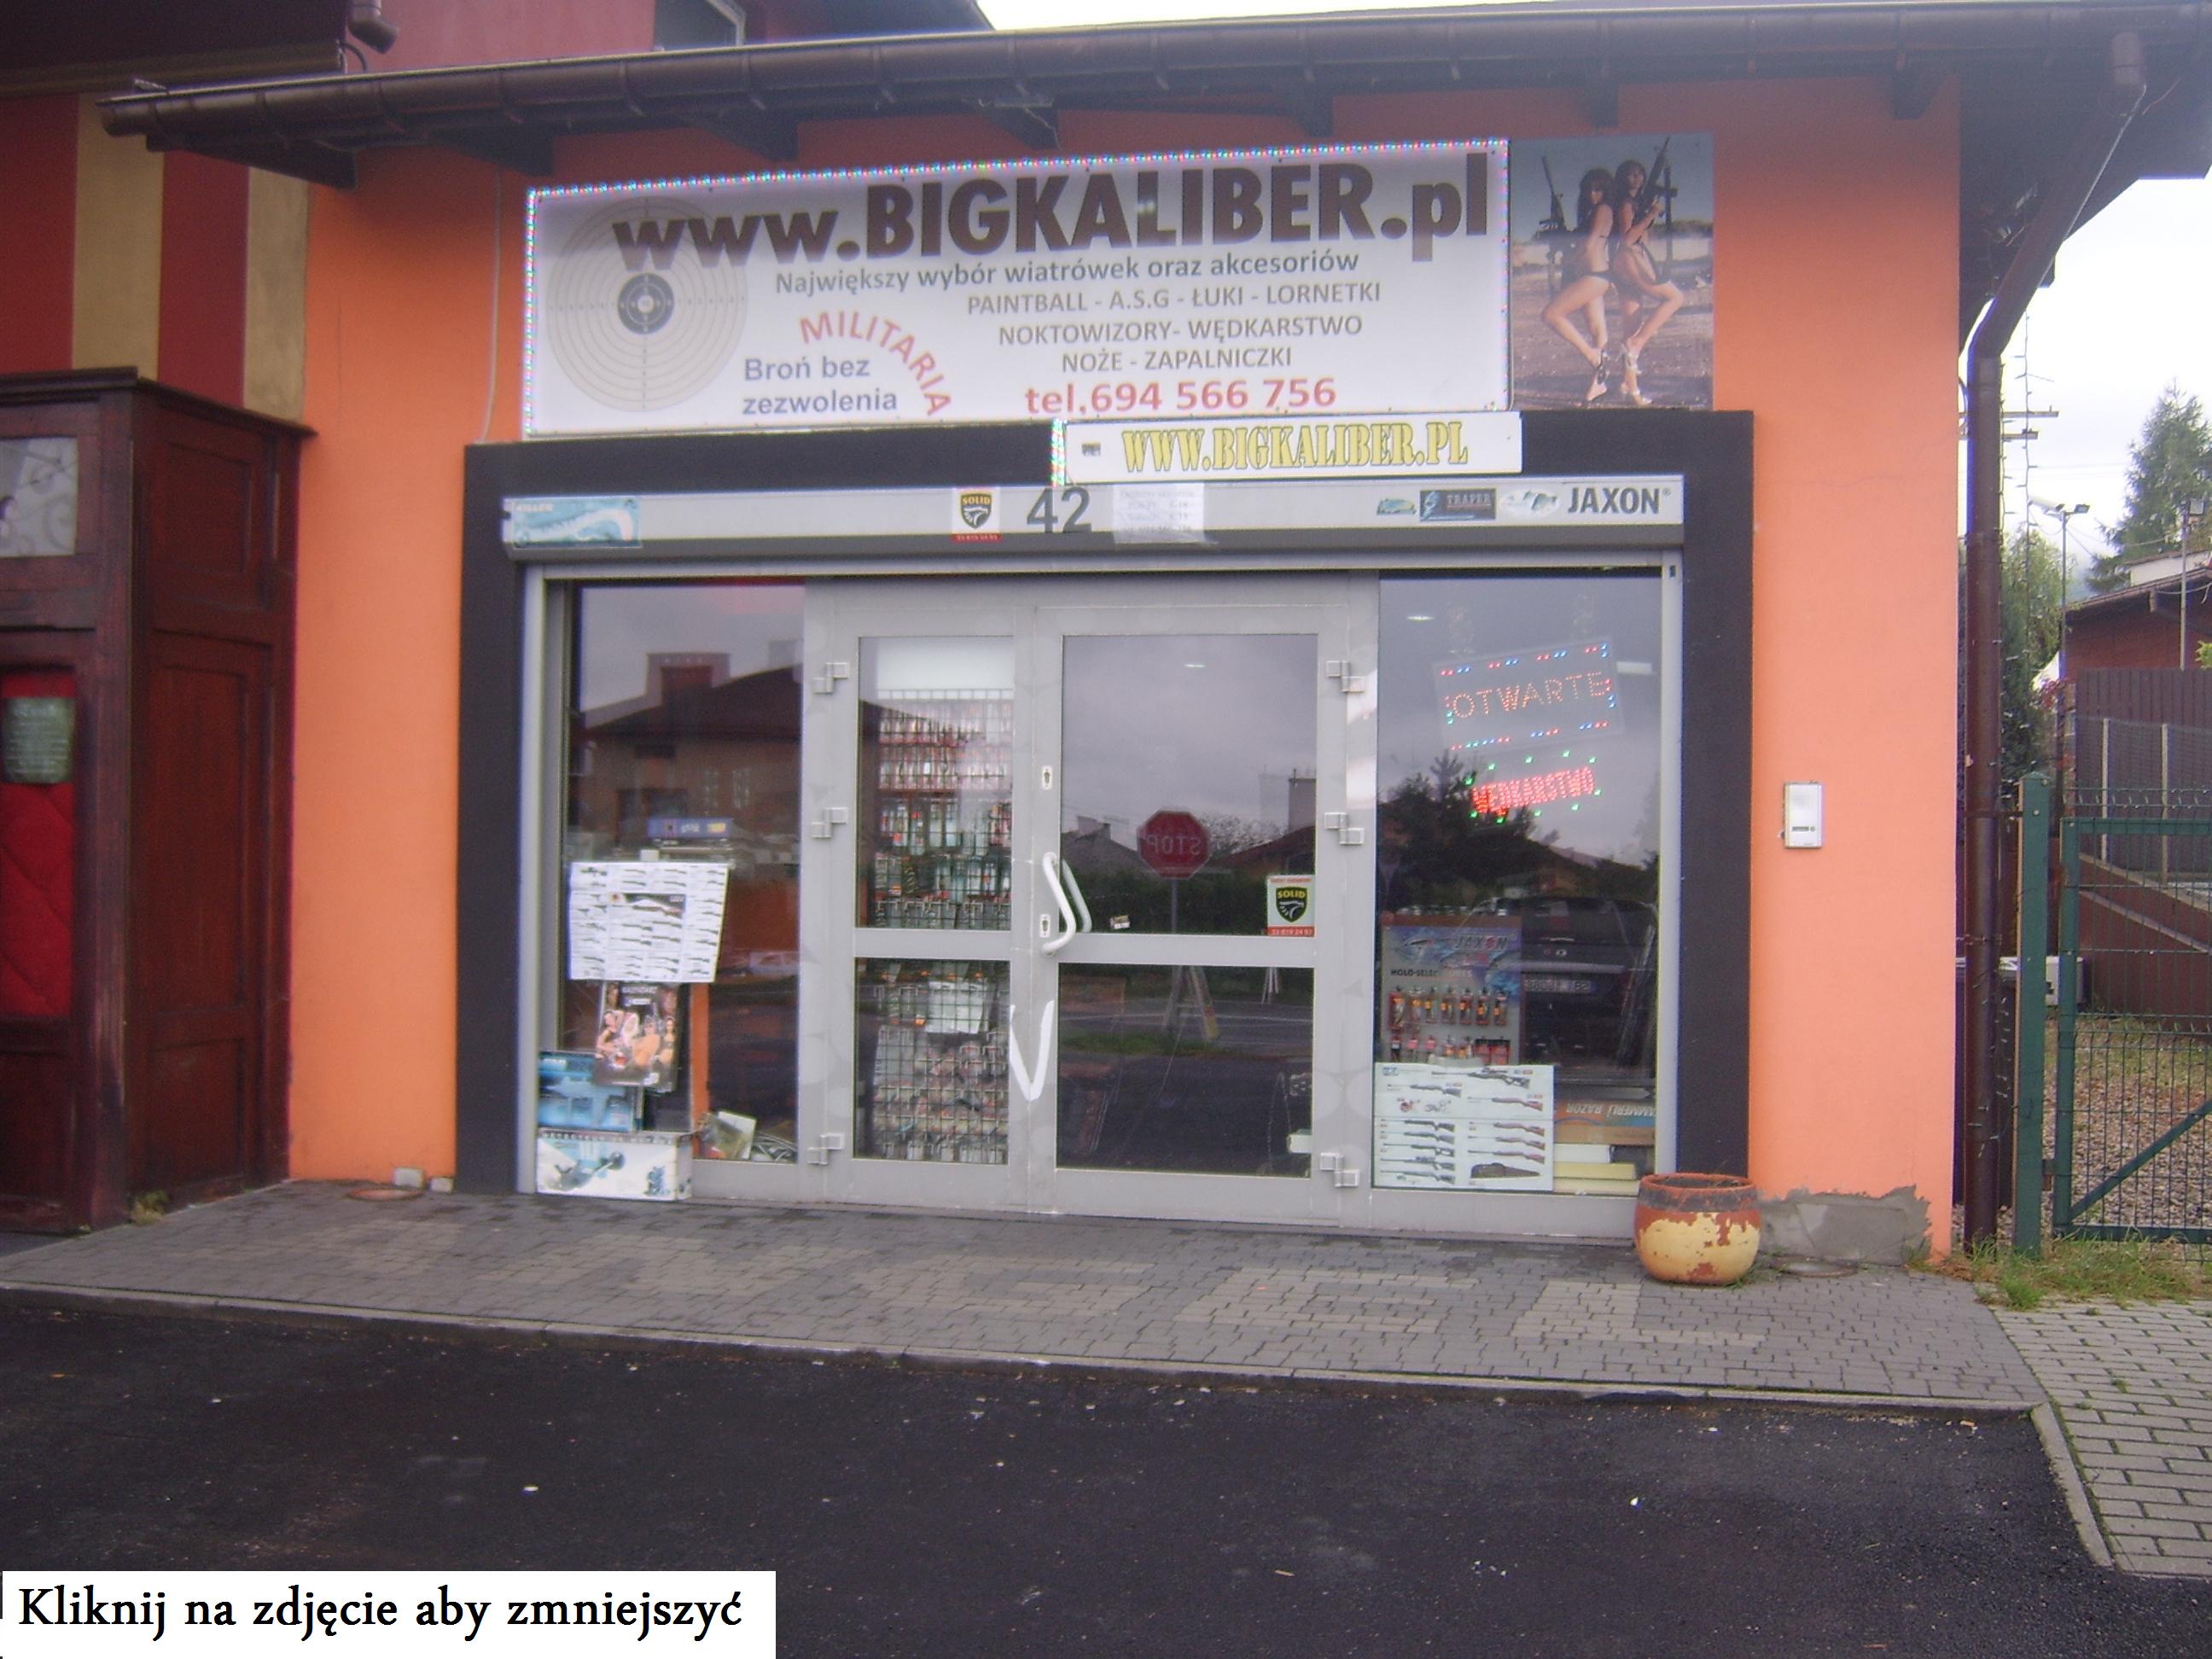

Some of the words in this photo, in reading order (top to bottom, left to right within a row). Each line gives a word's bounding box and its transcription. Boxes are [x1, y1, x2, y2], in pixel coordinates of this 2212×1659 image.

[612, 153, 1487, 272] www.BIGKALIBER.pl
[776, 268, 909, 297] Największy
[918, 262, 996, 291] wybór
[1004, 256, 1139, 283] wiatrówek
[1148, 259, 1202, 278] oraz
[1210, 248, 1359, 276] akcesoriów
[968, 292, 1088, 315] PAINTBALL
[1109, 289, 1170, 311] A.S.G
[1192, 286, 1243, 307] ŁUKI
[1266, 282, 1381, 306] LORNETKI
[1187, 315, 1363, 343] WĘDKARSTWO
[744, 355, 812, 381] Broń
[822, 354, 870, 379] bez
[800, 310, 952, 416] MILITARIA
[1061, 347, 1123, 374] NOŻE
[1144, 346, 1292, 370] ZAPALNICZKI
[742, 388, 898, 416] zezwolenia
[1176, 379, 1249, 410] 566
[1262, 376, 1337, 409] 756
[1121, 421, 1469, 472] WWW.BIGKALIBER.PL
[962, 496, 991, 506] SOLID
[1027, 486, 1092, 533] 42
[1452, 672, 1607, 718] OTWARTE
[1278, 889, 1306, 899] SOLID
